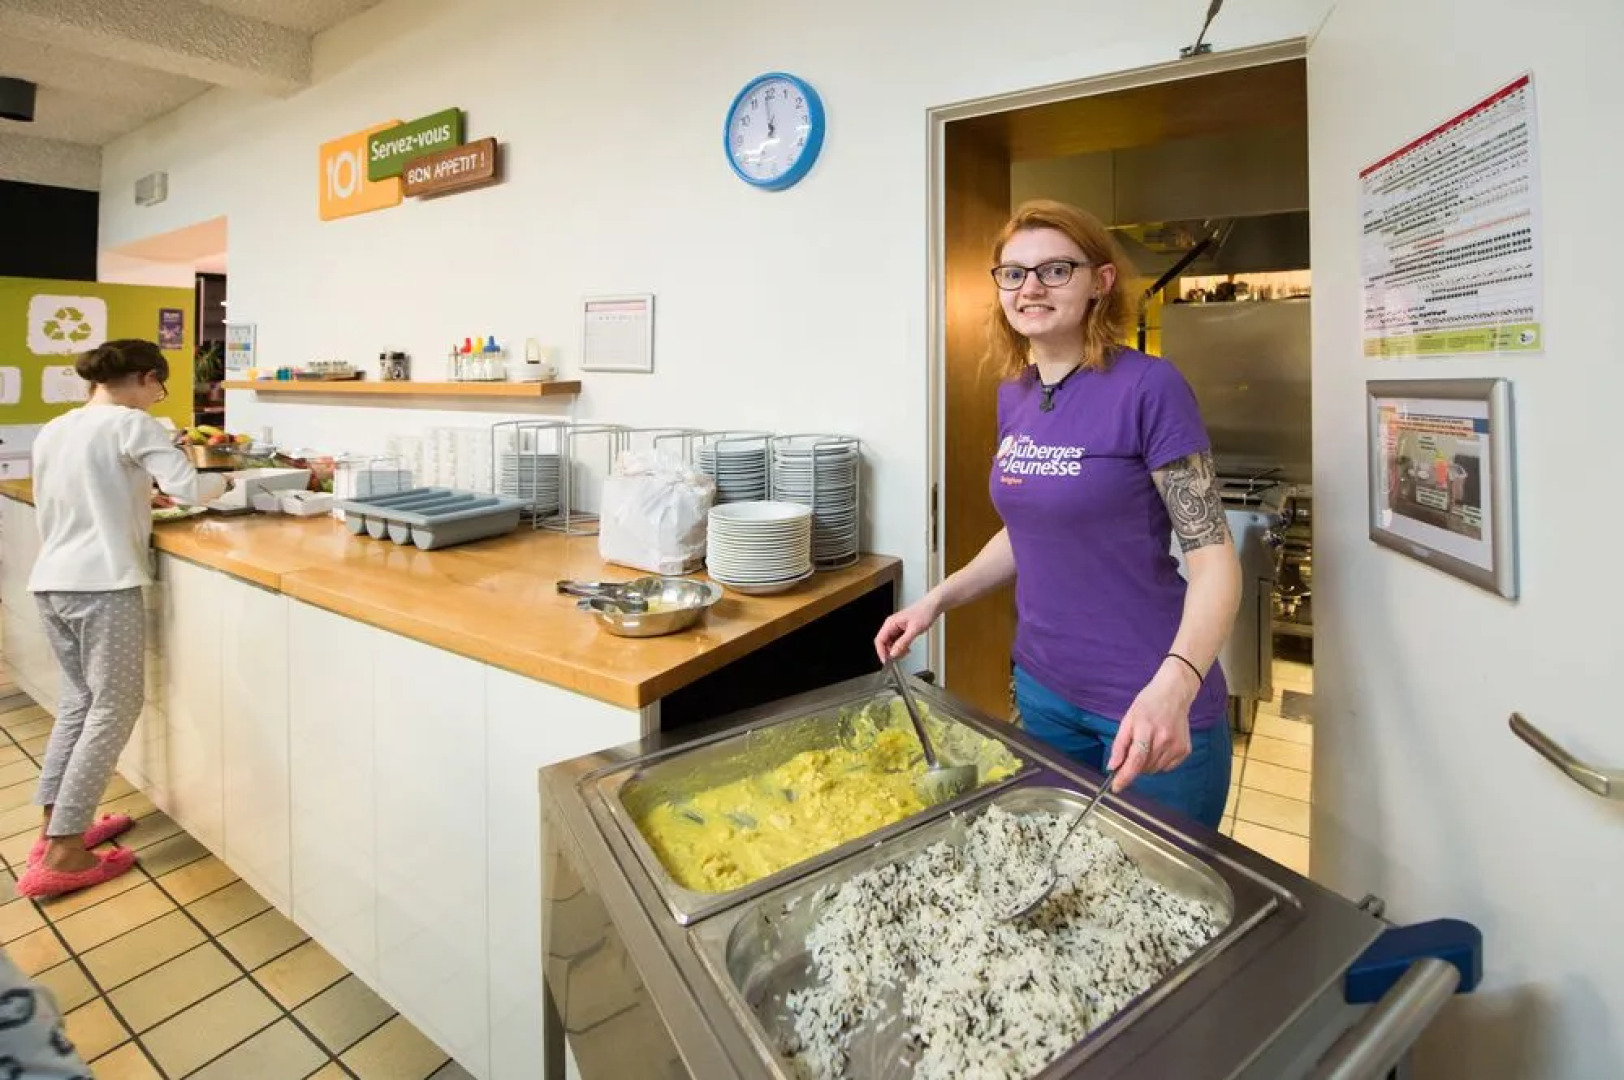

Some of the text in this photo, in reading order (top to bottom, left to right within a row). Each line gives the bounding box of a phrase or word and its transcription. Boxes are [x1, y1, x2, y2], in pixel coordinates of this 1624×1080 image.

[371, 124, 450, 161] Servez-vous
[407, 165, 431, 185] BON
[434, 153, 478, 178] APPETIT
[1007, 440, 1085, 462] Auberges
[1003, 455, 1082, 476] Jeunesse
